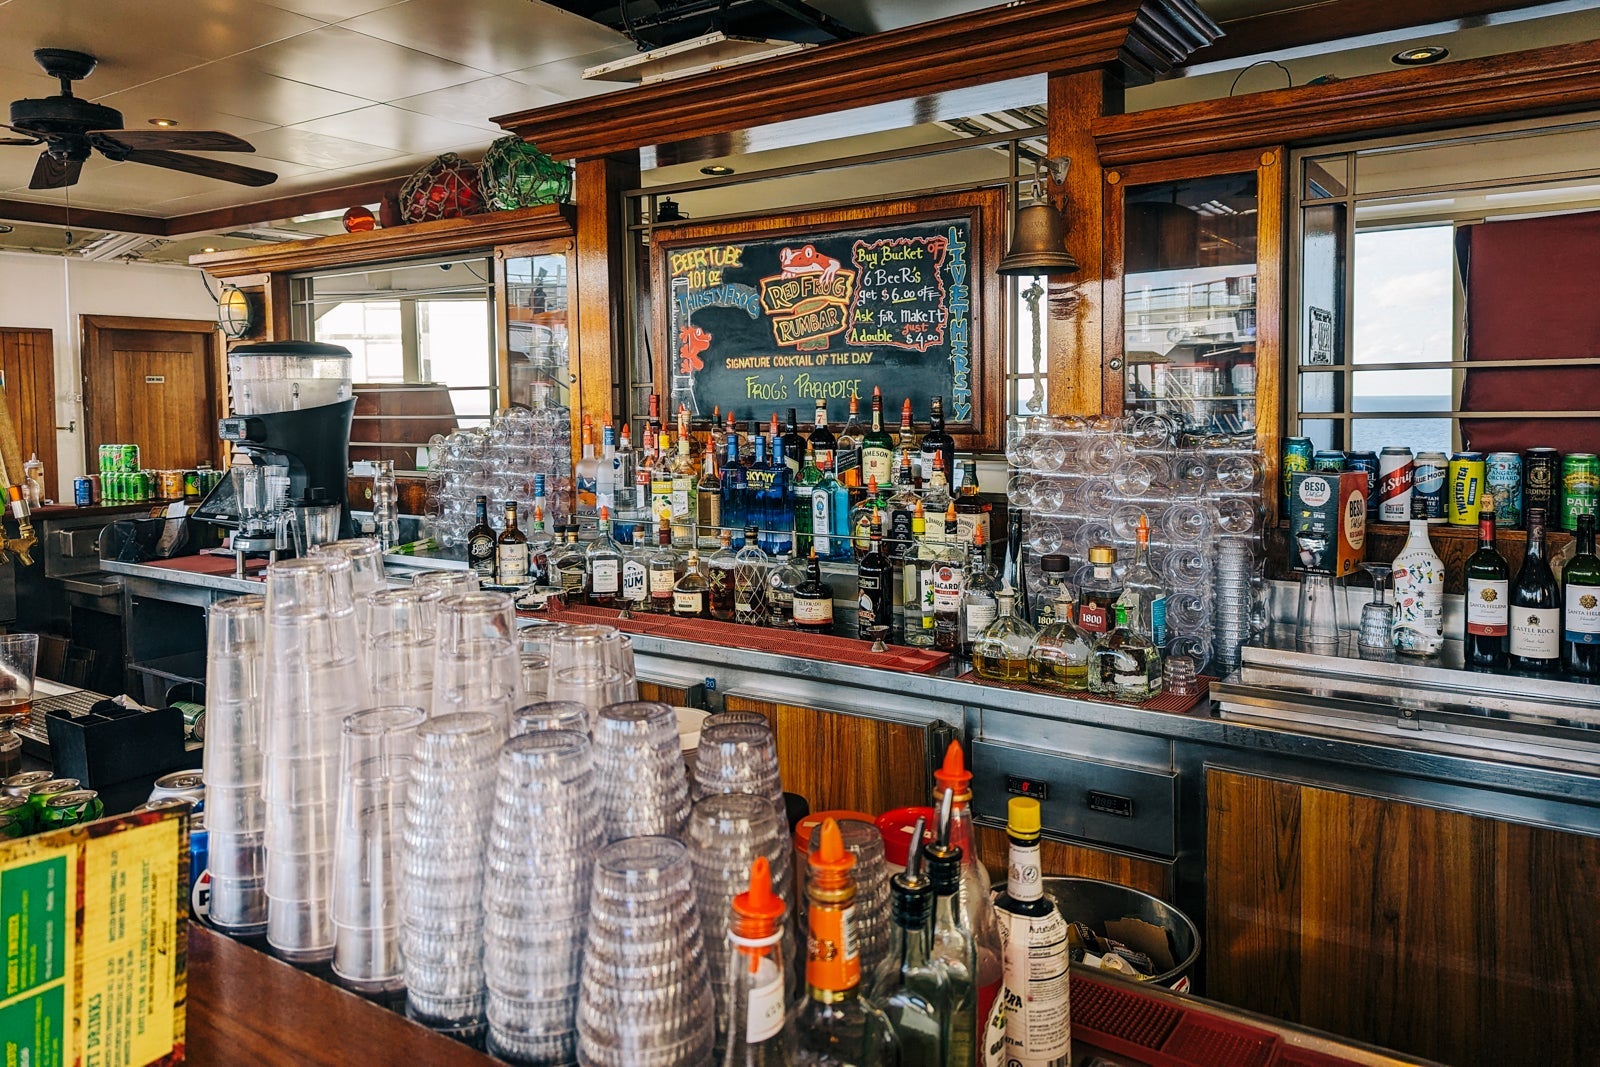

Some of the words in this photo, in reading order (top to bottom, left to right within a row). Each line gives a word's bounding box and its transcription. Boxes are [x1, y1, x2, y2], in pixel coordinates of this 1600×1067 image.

[671, 250, 707, 276] BEER
[704, 245, 743, 269] TUBE
[857, 248, 878, 269] Buy
[881, 245, 924, 266] Bucket
[688, 270, 708, 289] 101
[863, 270, 872, 287] 6
[767, 281, 801, 310] RED
[800, 275, 847, 298] FROG
[856, 289, 878, 307] get
[676, 286, 726, 317] THIRSTY
[723, 284, 761, 320] FROG
[853, 308, 875, 323] Ask
[850, 327, 860, 343] A
[859, 328, 893, 343] double
[726, 355, 771, 370] SIGNATURE
[773, 354, 815, 368] COCKTAIL
[815, 353, 829, 366] OF
[830, 352, 850, 366] THE
[851, 351, 874, 365] DAY
[793, 372, 863, 401] PARADISE
[816, 414, 823, 424] 7
[863, 450, 889, 459] JAMESON
[1427, 469, 1446, 480] MOON
[1456, 466, 1469, 481] TEA
[1304, 481, 1326, 492] BESO
[1455, 481, 1468, 516] TWISTED
[1566, 497, 1598, 507] PALE
[1569, 507, 1595, 516] ALE
[623, 575, 644, 589] RUM
[1082, 613, 1102, 625] 1800
[1512, 625, 1535, 634] CASTLE
